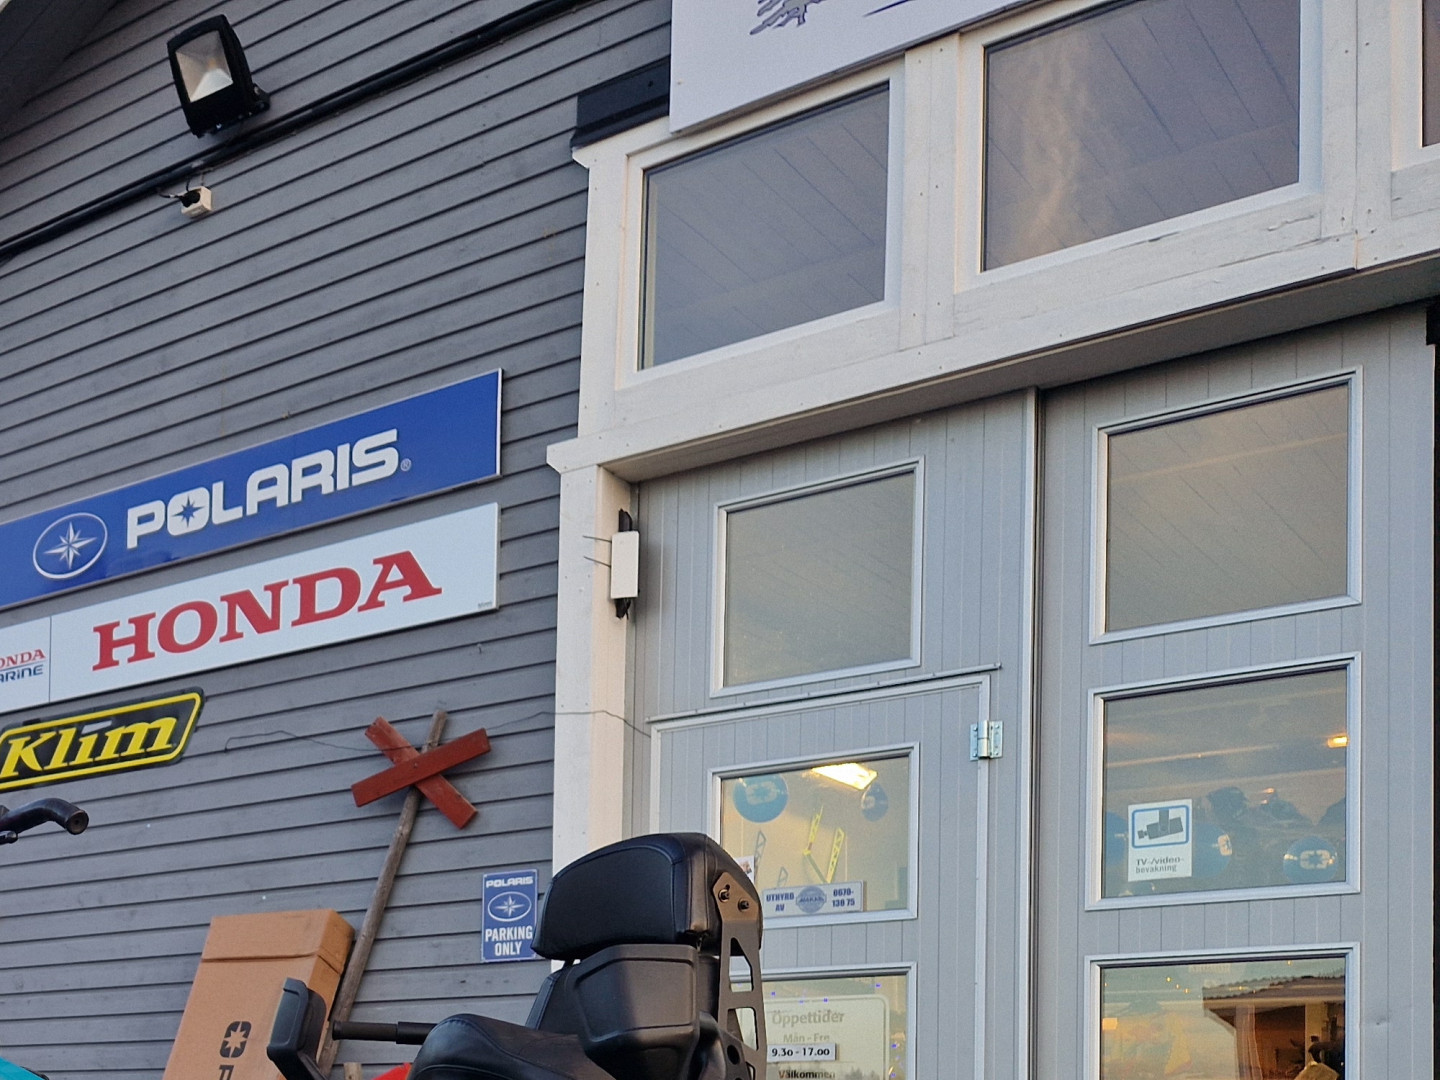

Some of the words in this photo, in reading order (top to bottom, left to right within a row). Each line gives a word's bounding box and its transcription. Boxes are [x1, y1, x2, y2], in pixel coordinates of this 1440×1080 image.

[126, 429, 398, 550] POLARIS
[92, 550, 442, 671] HONDA
[485, 876, 534, 889] POLARIS
[485, 925, 533, 943] PARKING
[494, 941, 523, 957] ONLY
[771, 1009, 846, 1029] Öppettider
[802, 1046, 831, 1057] 17.00
[778, 1068, 836, 1080] Välkommen
